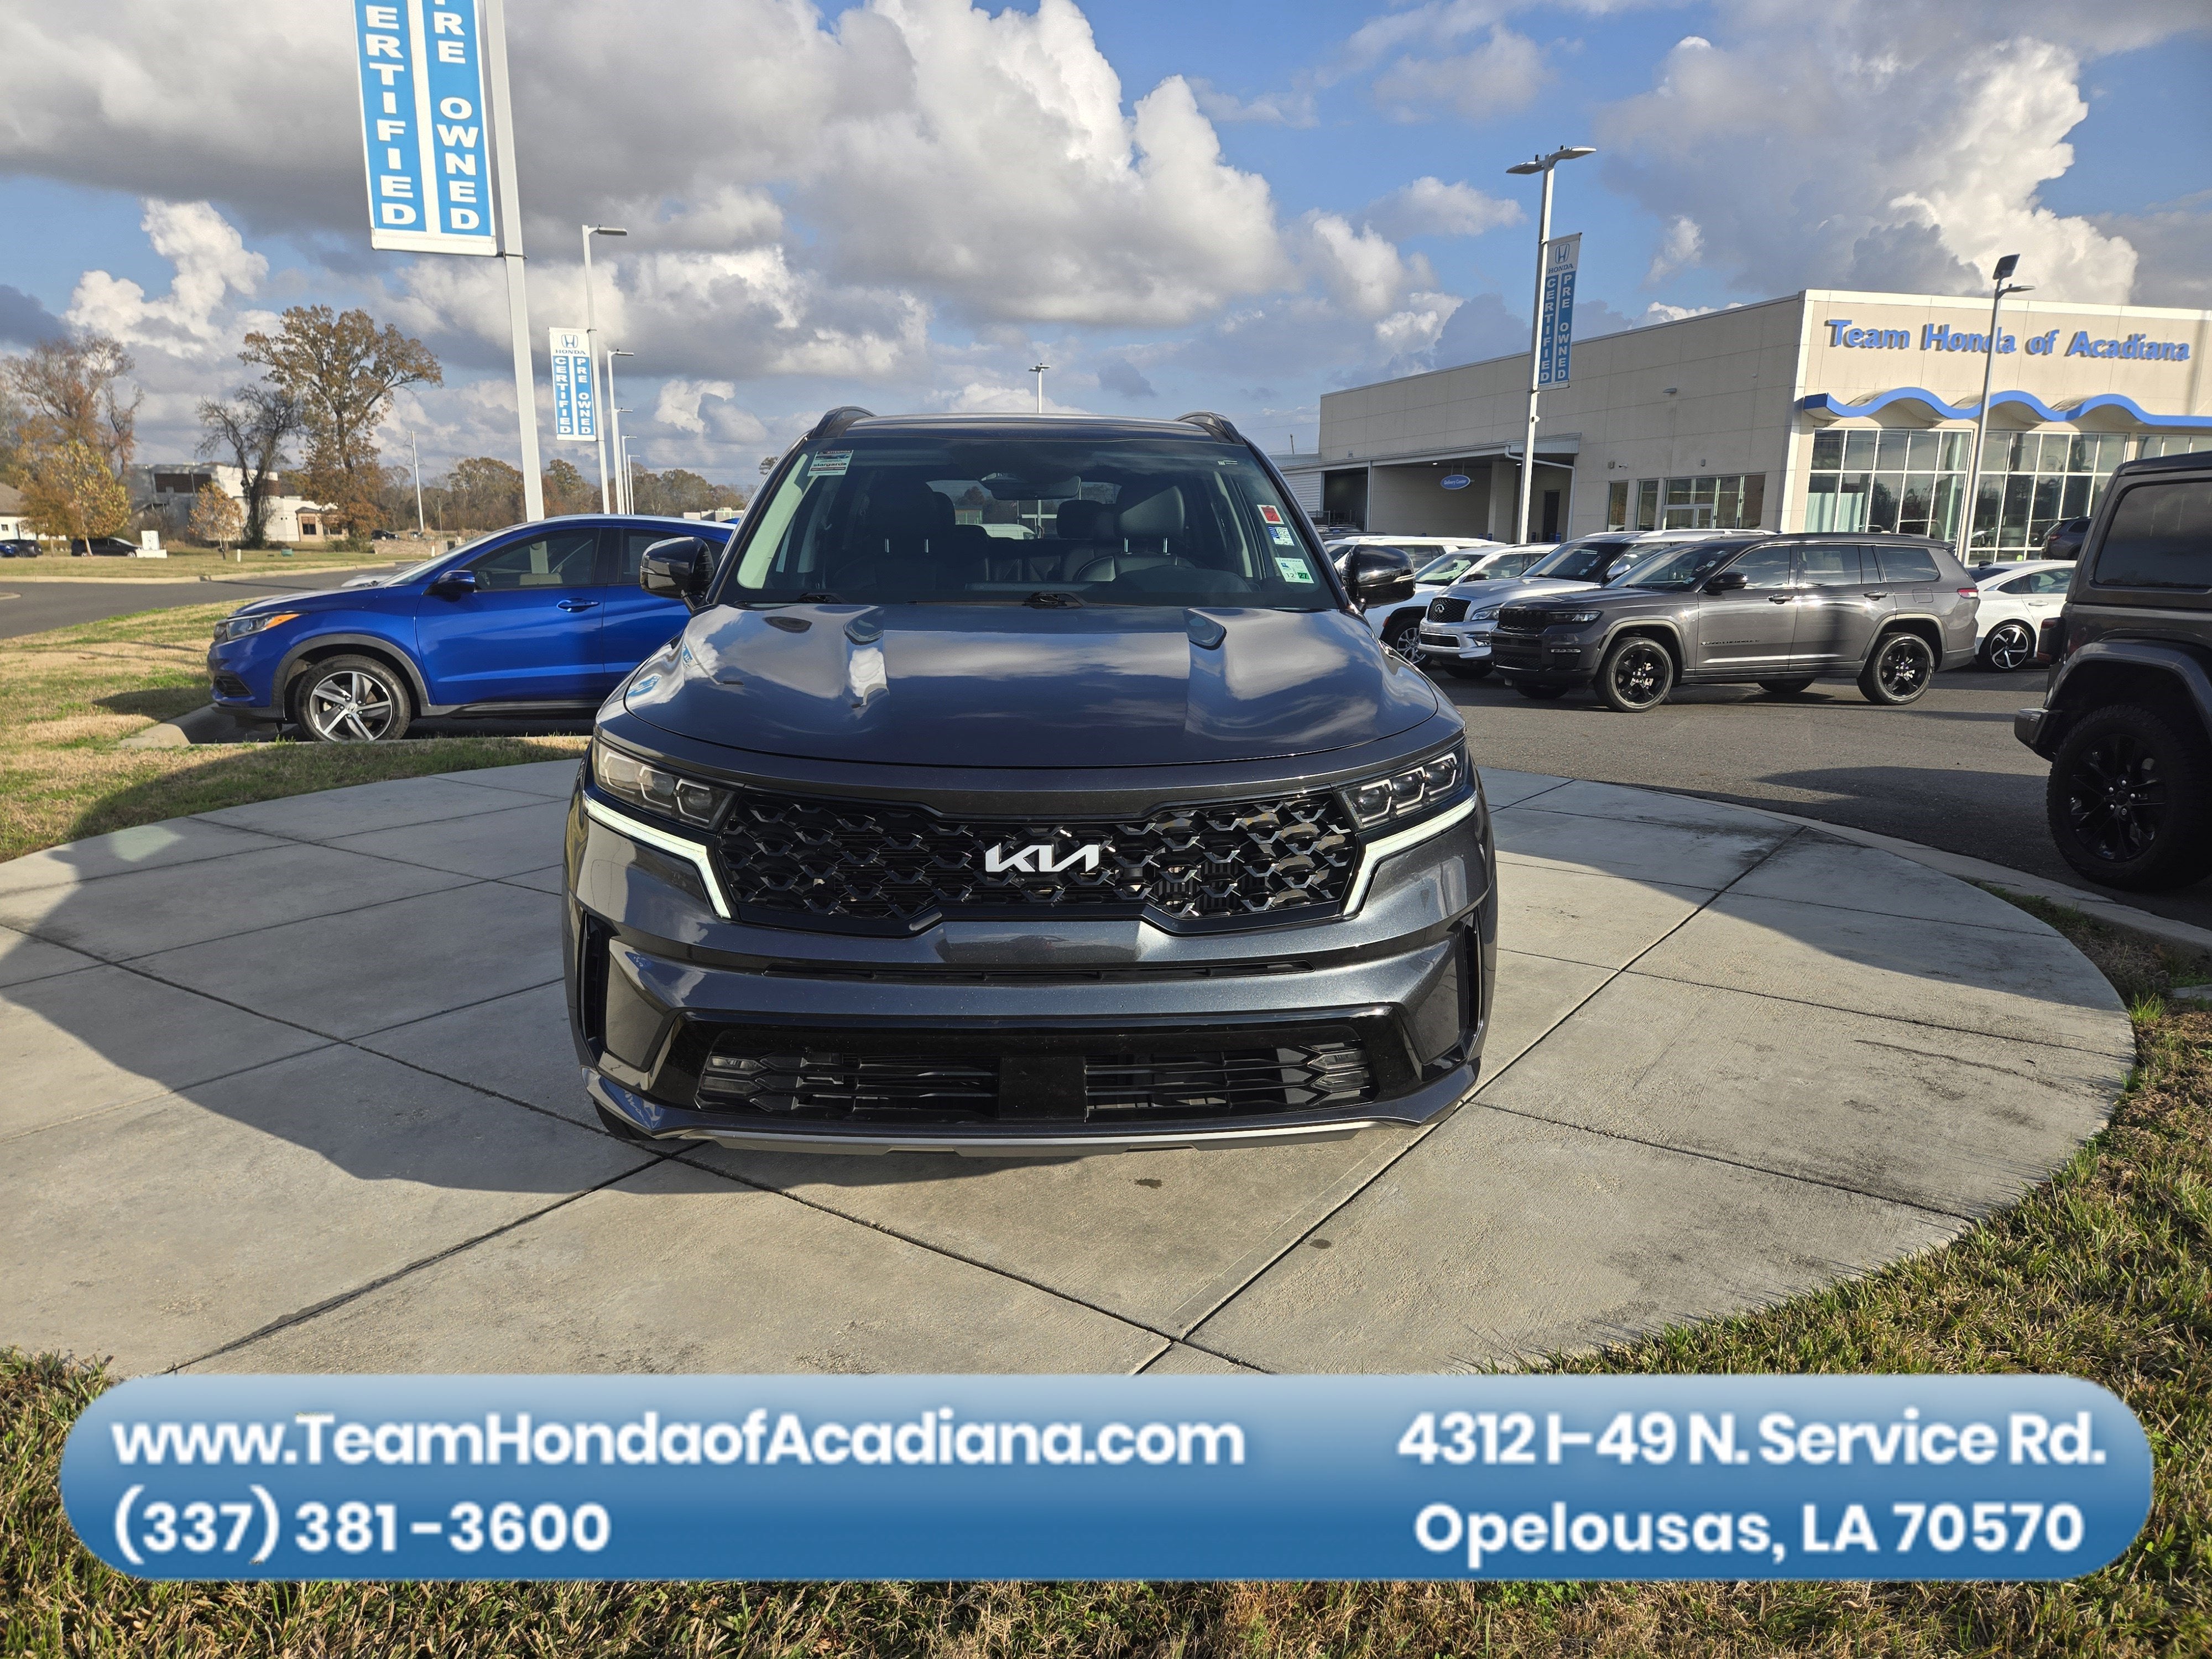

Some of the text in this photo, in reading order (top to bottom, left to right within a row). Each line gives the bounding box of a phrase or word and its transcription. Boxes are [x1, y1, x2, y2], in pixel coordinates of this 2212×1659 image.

[365, 4, 417, 225] ERTIFIED
[436, 96, 480, 230] OWNED
[1548, 263, 1574, 274] HONDA
[1540, 278, 1557, 382] CERTIFIED
[1557, 274, 1572, 379] PRE OWNED
[1825, 319, 2191, 361] Team Honda of Acadiana
[555, 357, 572, 434] CERTIFIED
[577, 358, 592, 434] PRE OWNED
[985, 844, 1099, 873] KIA
